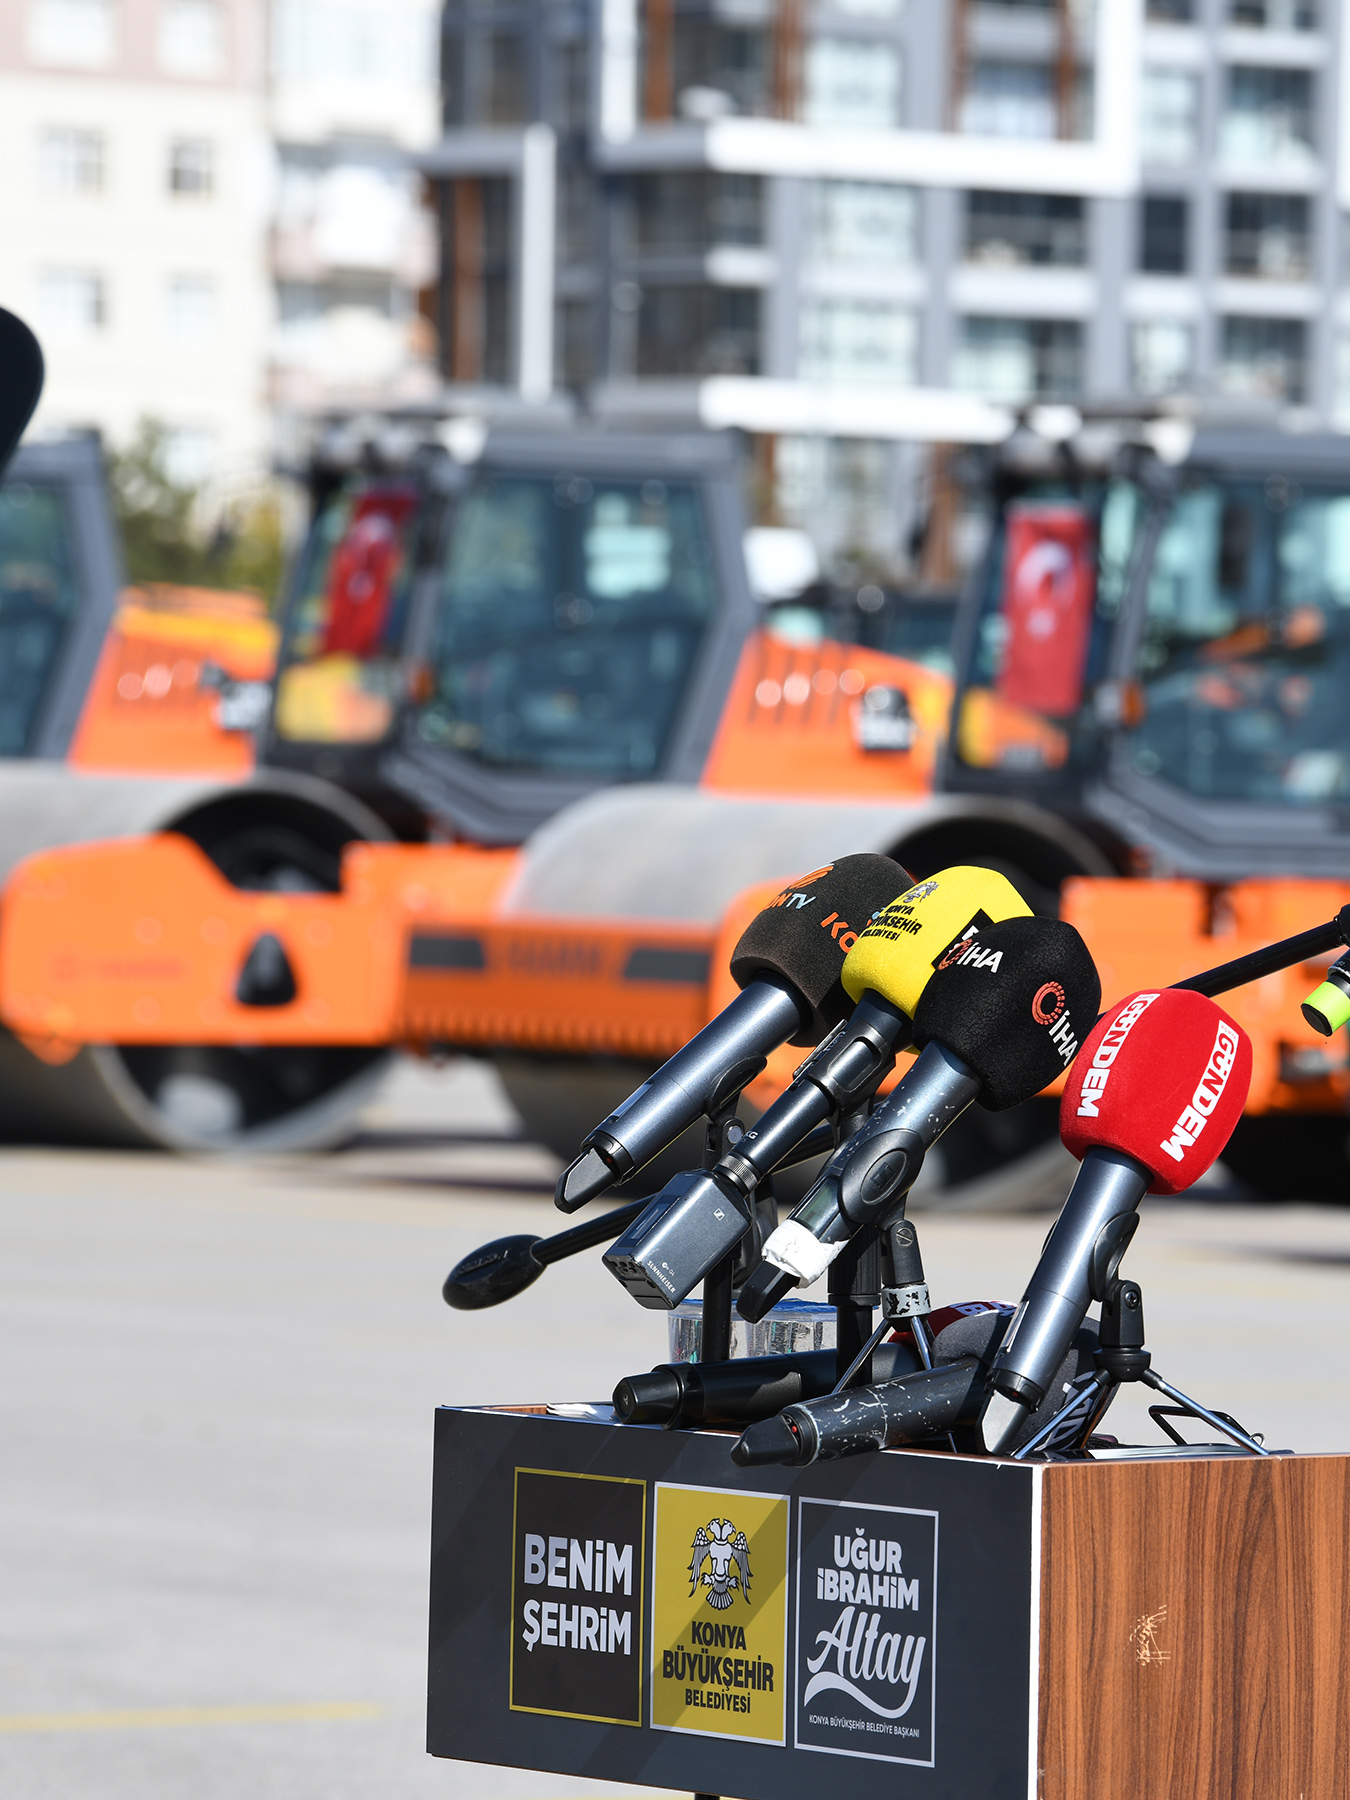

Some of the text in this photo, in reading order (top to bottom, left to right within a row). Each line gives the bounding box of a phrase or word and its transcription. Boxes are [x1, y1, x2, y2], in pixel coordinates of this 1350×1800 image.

[1077, 999, 1151, 1117] GÜNDEM
[1160, 1032, 1235, 1162] GÜNDEM
[834, 1528, 903, 1574] UĞUR
[817, 1568, 920, 1611] İBRAHİM
[692, 1621, 747, 1650] KONYA
[663, 1645, 774, 1692] BÜYÜKŞEHİR
[804, 1605, 927, 1719] Altay
[685, 1688, 750, 1713] BELEDİYESİ
[809, 1714, 920, 1738] KONYA BÜYÜKŞEHİR BELEDİYE BAŞKANI
